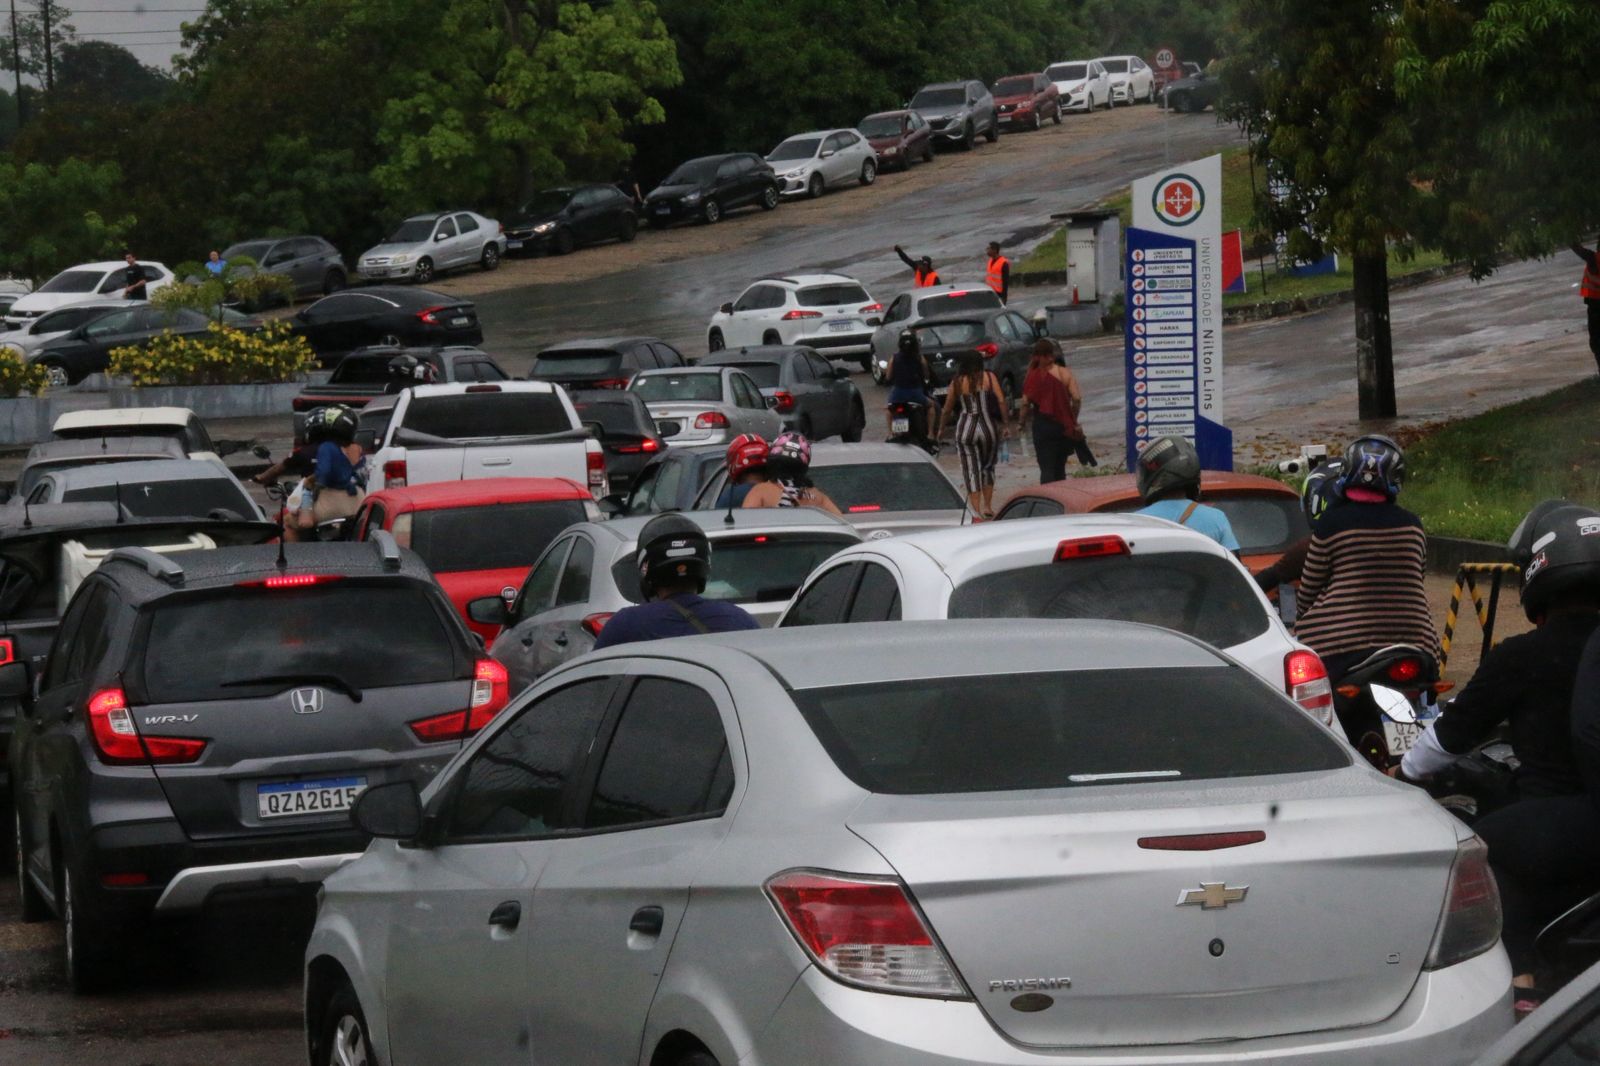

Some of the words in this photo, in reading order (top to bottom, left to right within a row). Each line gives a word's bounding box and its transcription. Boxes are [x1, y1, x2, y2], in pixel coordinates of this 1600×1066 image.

[1157, 52, 1171, 62] 40
[1201, 237, 1211, 324] UNIVERSIDADE
[1203, 329, 1214, 374] Nilton
[1203, 379, 1215, 410] Lins
[1580, 525, 1600, 536] GD
[145, 713, 199, 725] WR-V
[268, 788, 357, 814] QZA2G15
[989, 977, 1072, 992] PRISMA
